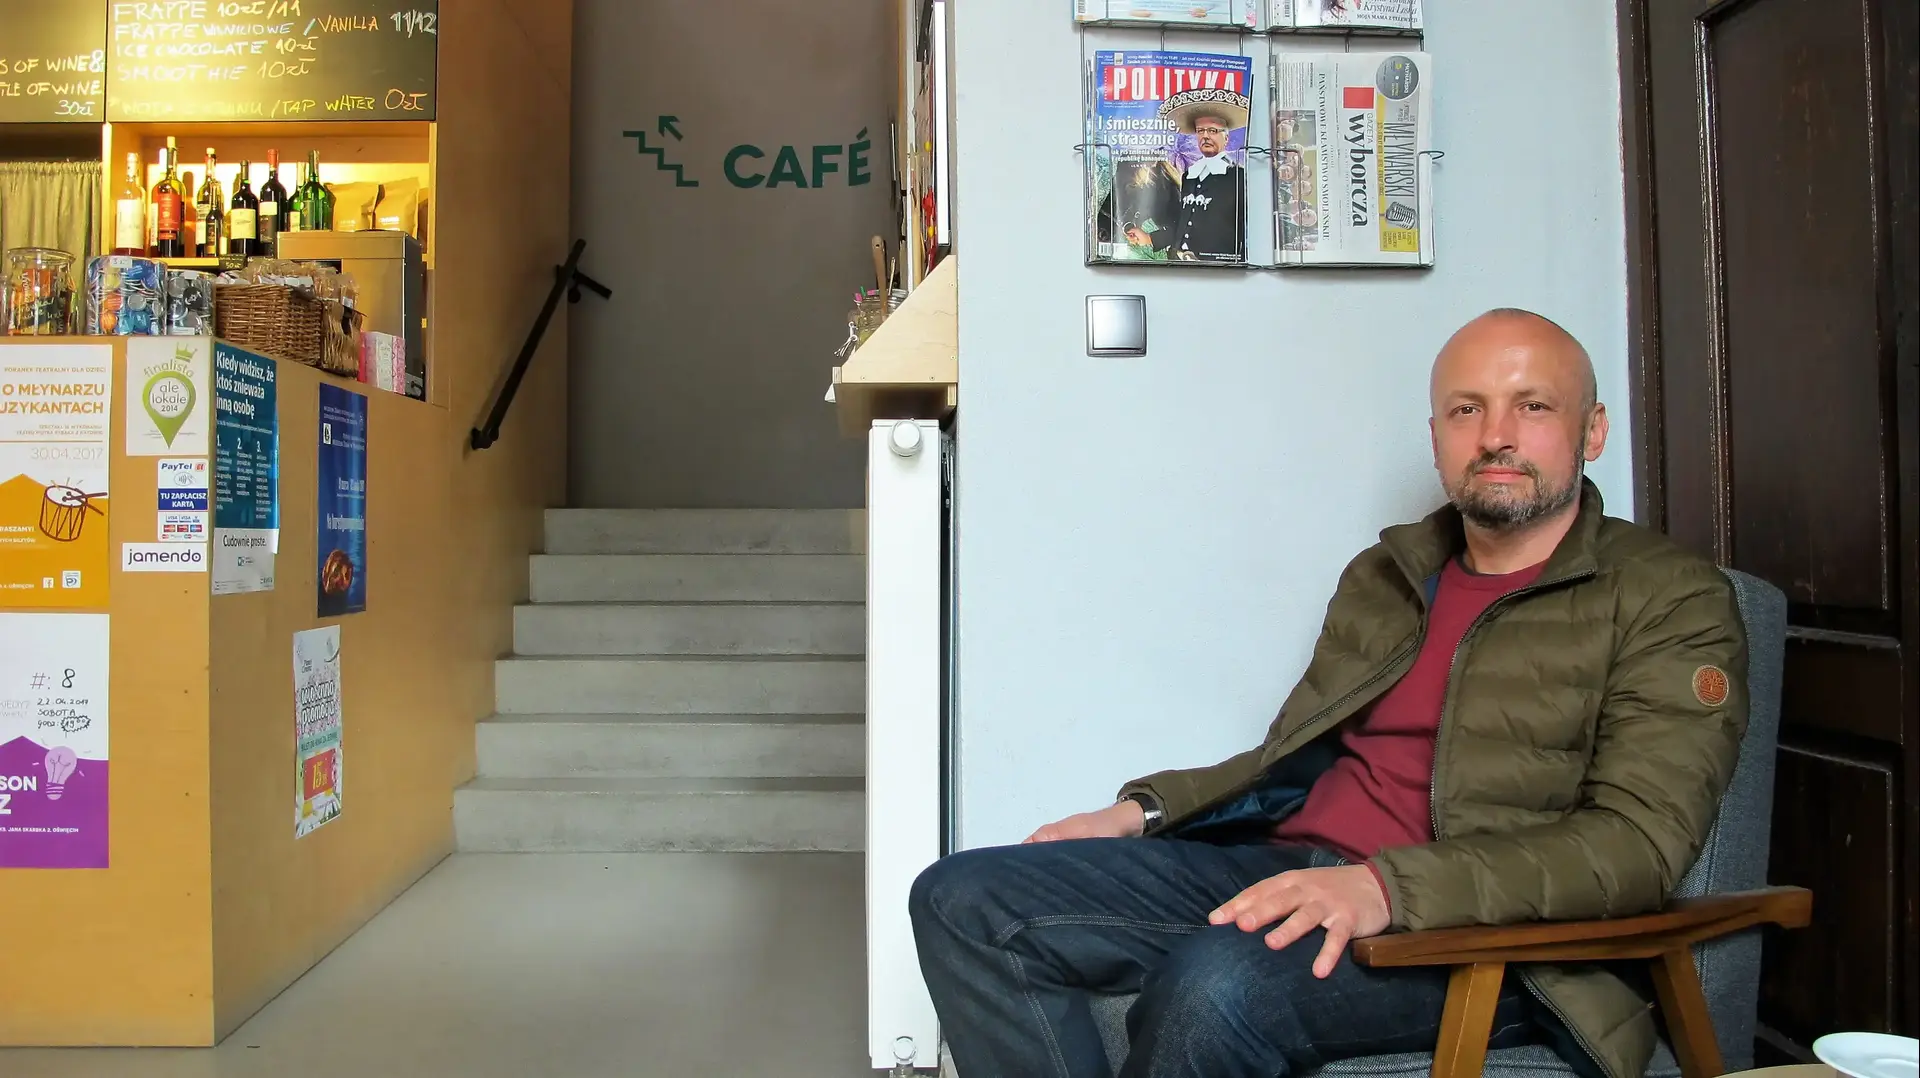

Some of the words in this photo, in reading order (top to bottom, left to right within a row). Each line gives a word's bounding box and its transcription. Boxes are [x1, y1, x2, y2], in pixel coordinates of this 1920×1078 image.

[113, 3, 206, 21] FRAPPE
[113, 23, 200, 41] FRAPPE
[14, 58, 40, 73] OF
[51, 79, 102, 96] WINE
[1113, 67, 1236, 101] POLITYKA
[1106, 115, 1180, 133] śmiesznie,
[1366, 112, 1374, 144] GAZETA
[1111, 132, 1175, 146] strasznie
[723, 126, 871, 188] CAFÉ
[1384, 122, 1415, 197] MŁYNARSKI
[1344, 113, 1374, 227] wyborcza
[143, 358, 195, 378] finalista
[216, 351, 239, 375] Kiedy
[238, 359, 266, 382] widzisz,
[266, 365, 274, 383] że
[18, 383, 105, 396] MŁYNARZU
[159, 381, 179, 393] ale
[216, 371, 233, 391] ktoś
[233, 377, 265, 399] znieważa
[152, 393, 187, 404] lokale
[216, 392, 233, 415] inną
[233, 399, 255, 420] osobę
[30, 447, 104, 460] 30.04.2017
[161, 463, 193, 471] PayTel
[160, 492, 170, 500] TU
[171, 492, 207, 500] ZAPŁACISZ
[172, 501, 195, 509] KARTĄ
[222, 534, 250, 547] Cudownie
[128, 548, 202, 565] jamendo
[61, 668, 76, 689] 8
[37, 708, 76, 717] SOBOTA
